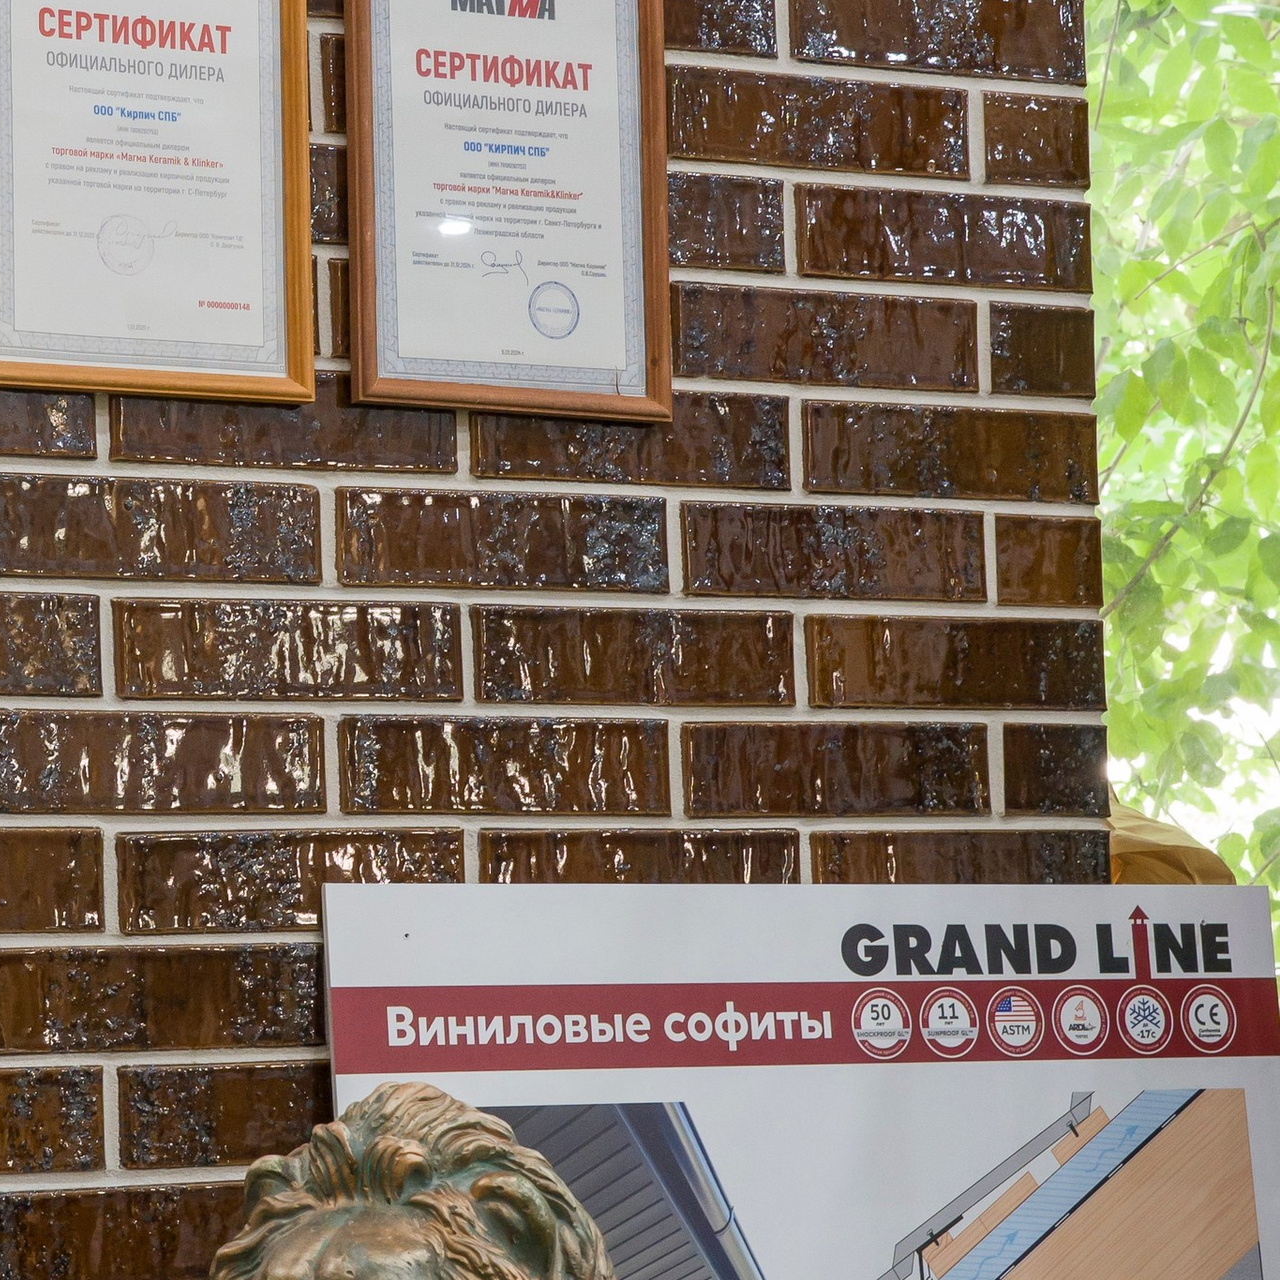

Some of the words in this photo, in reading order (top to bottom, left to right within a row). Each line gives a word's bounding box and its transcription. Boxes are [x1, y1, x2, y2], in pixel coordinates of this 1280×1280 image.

[38, 7, 232, 54] СЕРТИФИКАТ
[46, 51, 164, 77] ОФИЦИАЛЬНОГО
[168, 63, 224, 83] ДИЛЕРА
[415, 48, 593, 91] СЕРТИФИКАТ
[93, 104, 114, 117] ООО
[116, 107, 156, 121] "Кирпич
[157, 110, 182, 123] СПБ"
[424, 90, 531, 113] ОФИЦИАЛЬНОГО
[535, 100, 587, 118] ДИЛЕРА
[463, 140, 483, 153] ООО
[484, 143, 526, 156] "КИРПИЧ
[527, 145, 550, 158] СПБ"
[841, 922, 1076, 977] GRAND
[1098, 911, 1233, 978] LINE
[871, 1004, 891, 1021] 50
[938, 1003, 959, 1019] 11
[386, 1006, 651, 1047] Виниловые
[664, 1001, 832, 1052] софиты
[1002, 1025, 1031, 1035] ASTM
